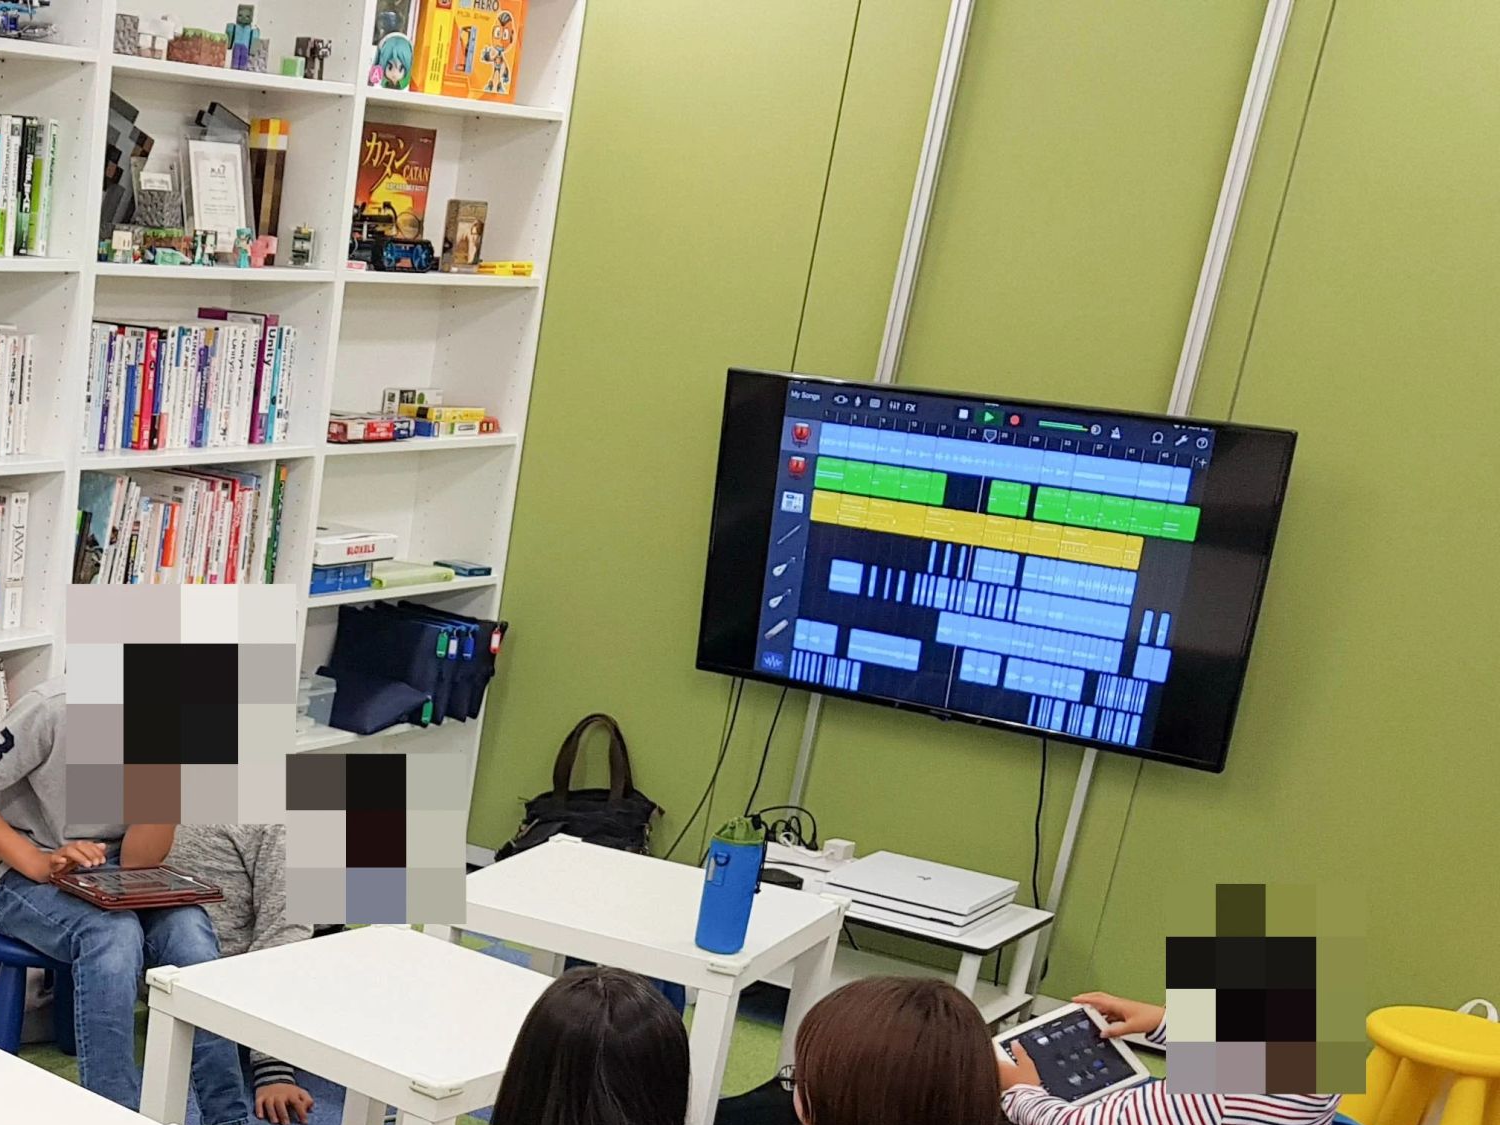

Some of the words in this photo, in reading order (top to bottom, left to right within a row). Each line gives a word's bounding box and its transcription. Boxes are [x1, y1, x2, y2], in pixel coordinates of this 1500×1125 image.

[362, 131, 414, 192] カタン
[402, 164, 431, 182] CATAN
[263, 328, 277, 367] Unity
[790, 389, 800, 399] My
[801, 391, 821, 401] Songs
[904, 403, 916, 412] FX
[12, 524, 25, 563] JAVA
